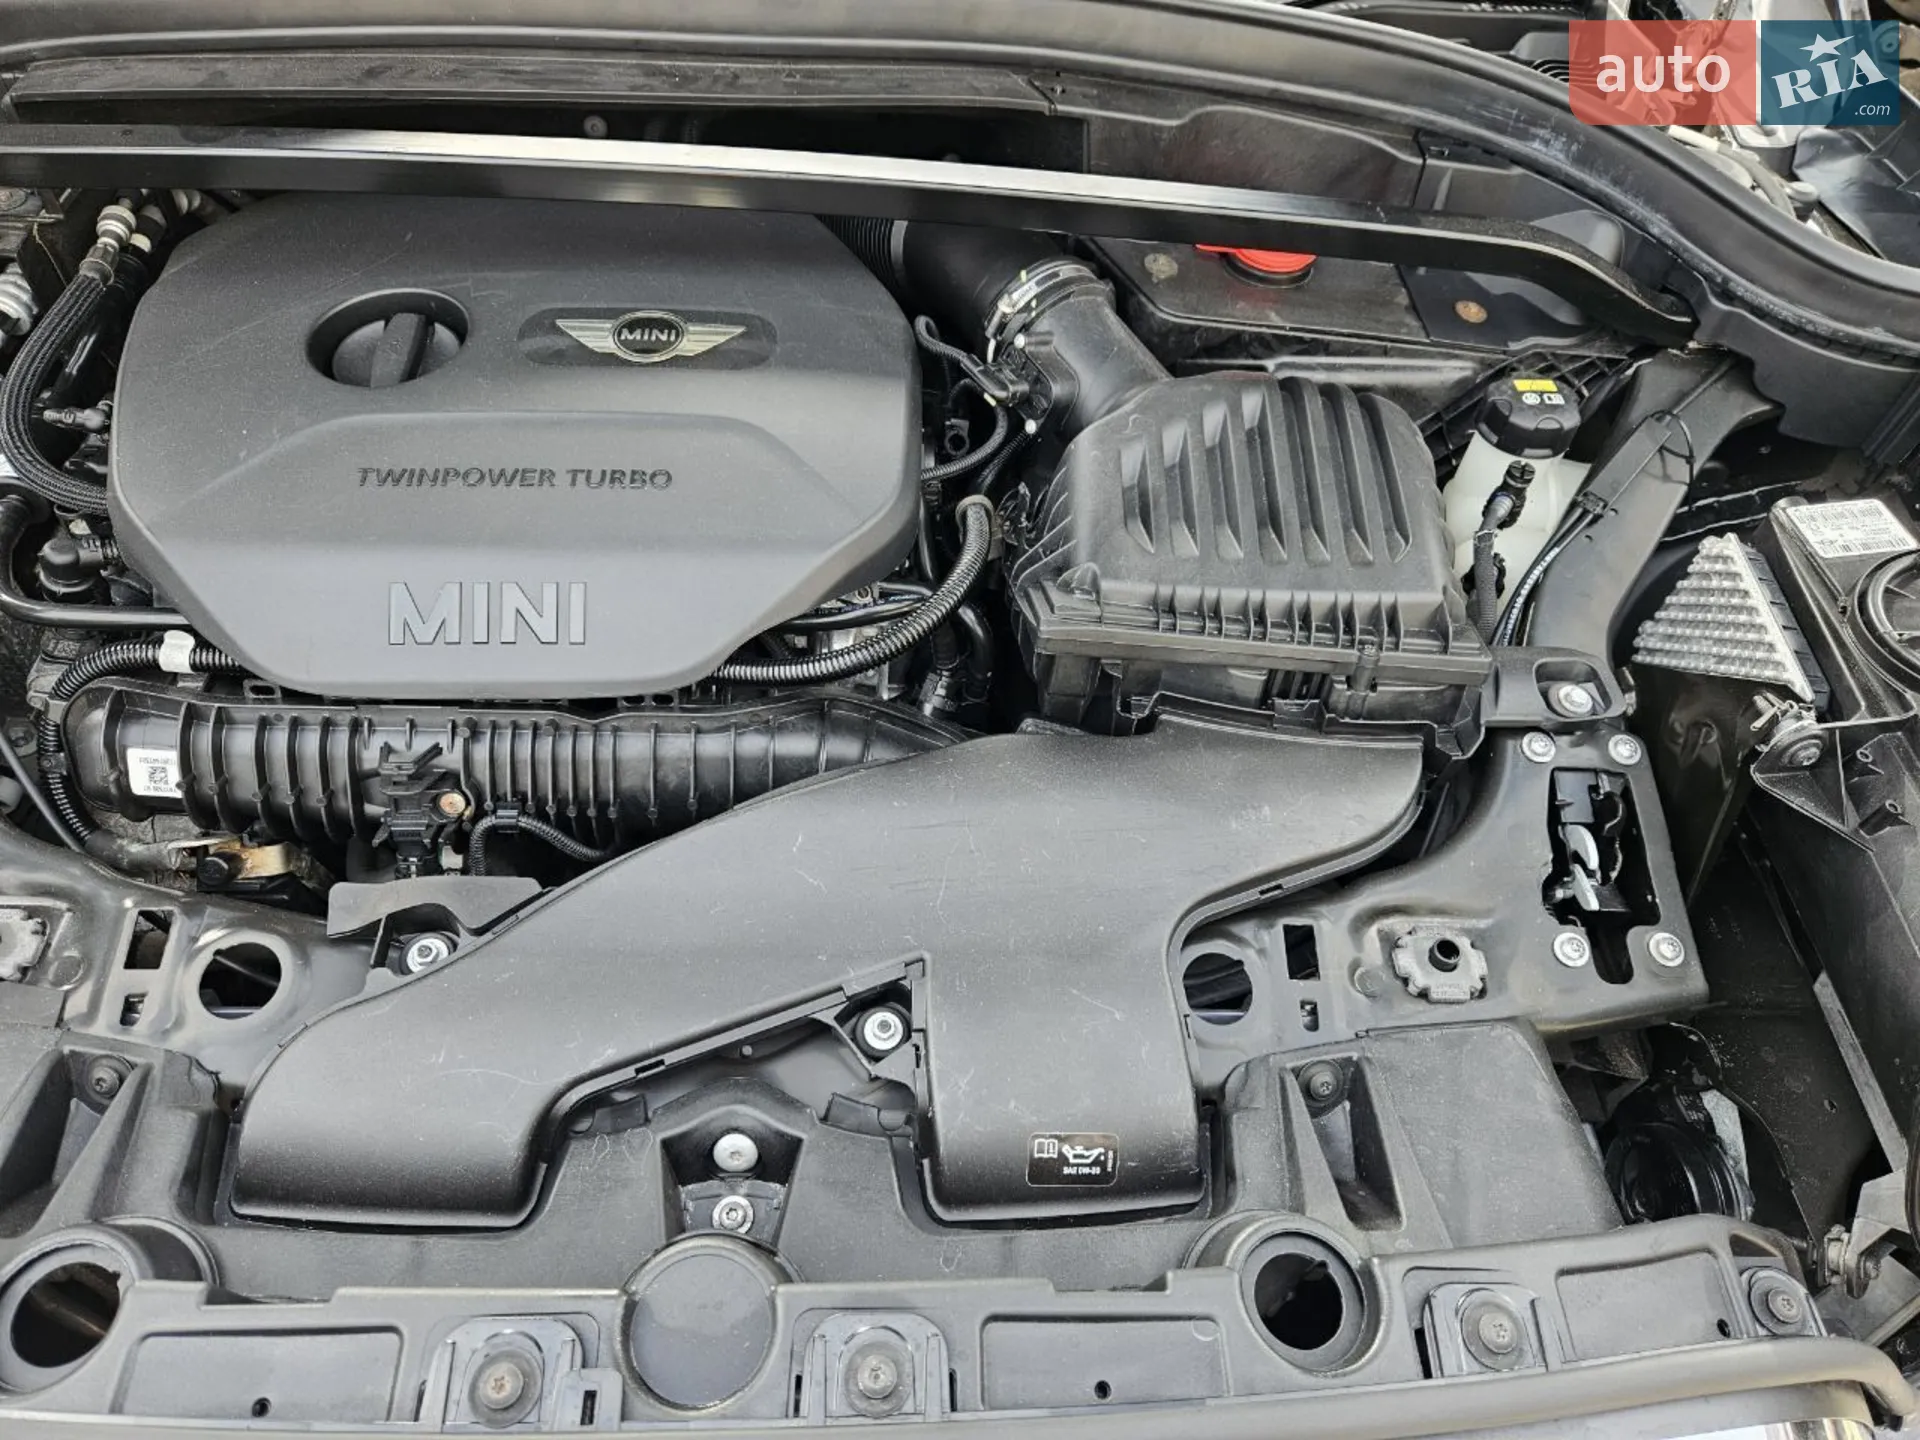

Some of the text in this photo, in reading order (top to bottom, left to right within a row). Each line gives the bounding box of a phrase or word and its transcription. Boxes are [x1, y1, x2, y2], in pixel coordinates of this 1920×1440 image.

[620, 327, 677, 341] MINI
[358, 467, 673, 490] TWINPOWER TURBO
[388, 581, 587, 645] MINI
